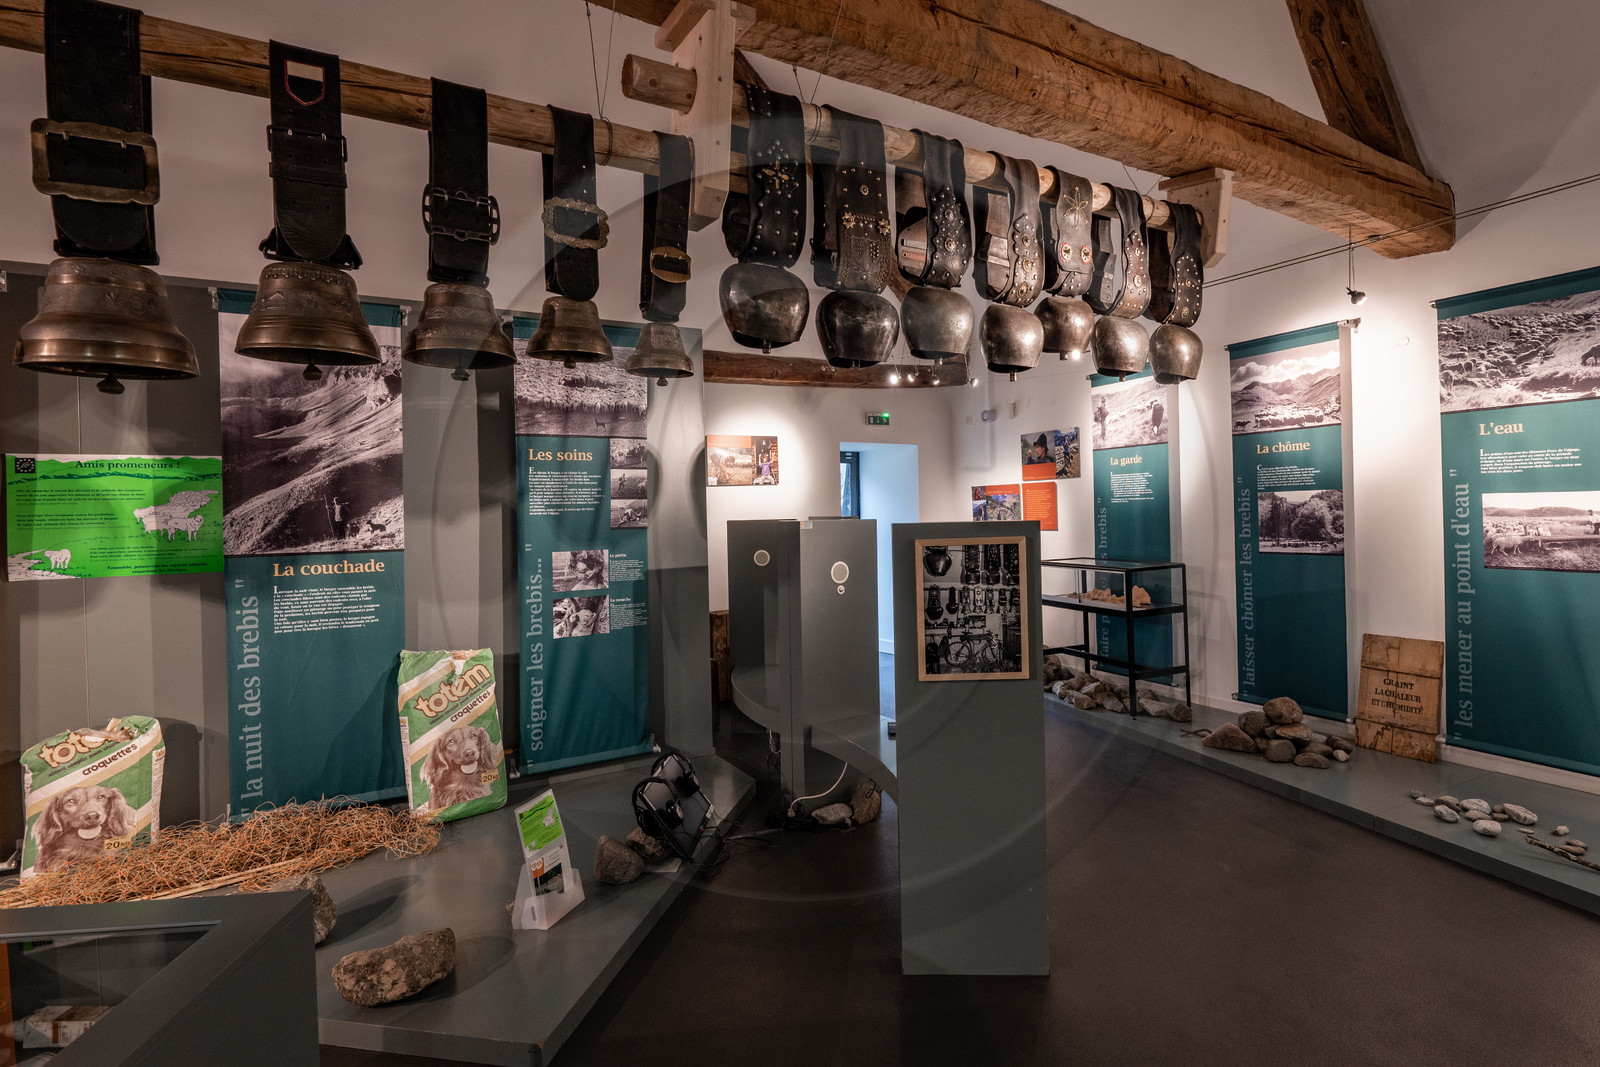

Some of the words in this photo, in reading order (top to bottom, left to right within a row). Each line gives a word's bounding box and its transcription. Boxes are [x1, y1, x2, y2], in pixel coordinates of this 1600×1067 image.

[1479, 422, 1524, 436] L'eau
[529, 449, 552, 460] Les
[557, 449, 592, 461] soins
[1110, 457, 1118, 466] La
[1121, 455, 1142, 466] garde
[1257, 444, 1269, 454] La
[1272, 441, 1310, 452] chôme
[75, 460, 104, 470] Amis
[107, 460, 173, 472] promeneurs
[1238, 488, 1251, 538] brebis
[1451, 483, 1470, 536] d'eau
[1098, 507, 1107, 548] brebis
[273, 564, 295, 576] La
[300, 558, 385, 575] couchade
[1240, 543, 1252, 564] les
[1452, 542, 1475, 594] point
[1241, 570, 1254, 630] chômer
[1458, 600, 1471, 624] au
[236, 596, 260, 670] brebis
[527, 642, 543, 671] les
[1243, 634, 1255, 686] laisser
[1458, 630, 1472, 694] mener
[238, 676, 261, 716] des
[413, 664, 492, 718] totem
[1383, 678, 1414, 689] CRAINT
[1385, 689, 1421, 703] CHALEUR
[450, 690, 490, 722] croquettes
[527, 677, 547, 751] soigner
[1455, 700, 1473, 728] les
[82, 743, 138, 776] croquettes
[239, 723, 262, 771] nuit
[241, 777, 263, 800] la
